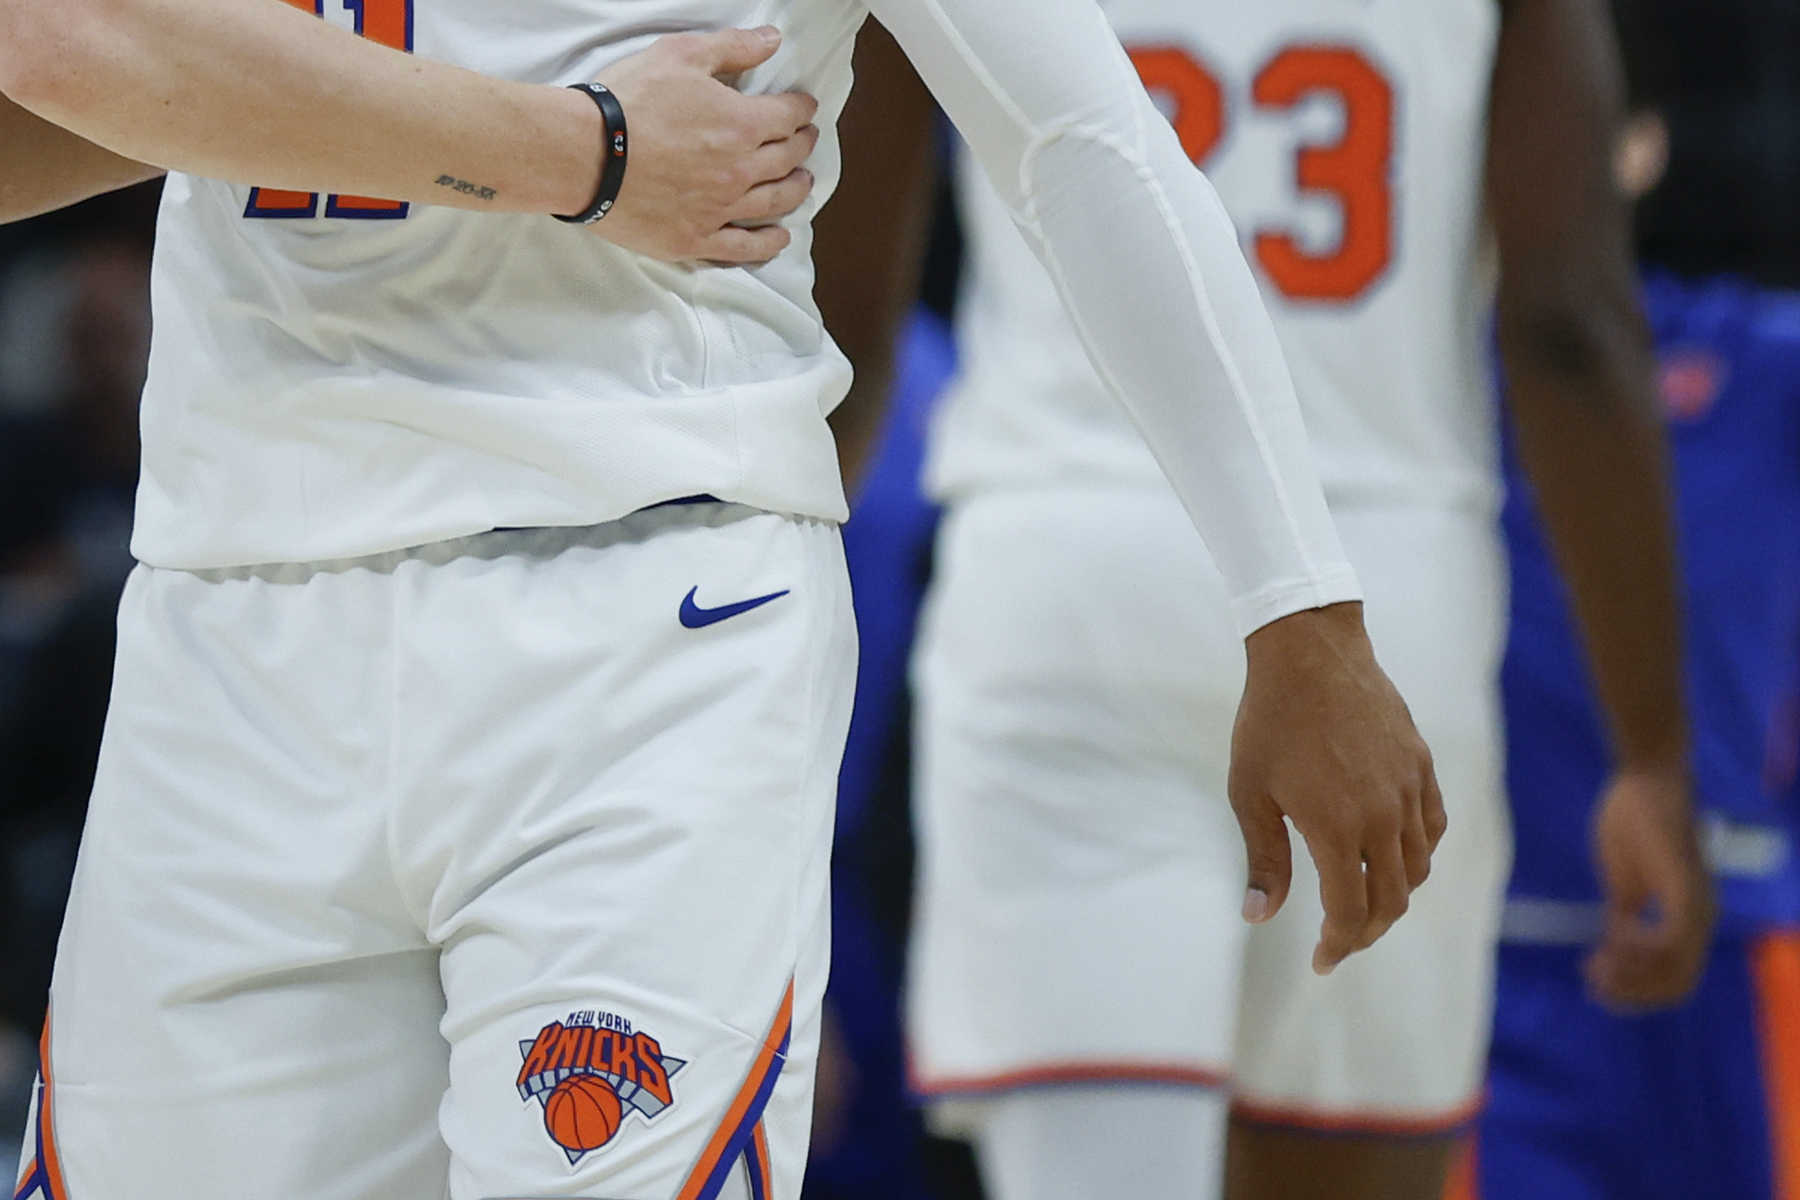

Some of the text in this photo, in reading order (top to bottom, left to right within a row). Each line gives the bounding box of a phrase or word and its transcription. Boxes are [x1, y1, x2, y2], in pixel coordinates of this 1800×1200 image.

[565, 1010, 633, 1035] NEW YORK
[516, 1019, 674, 1105] KNICKS
